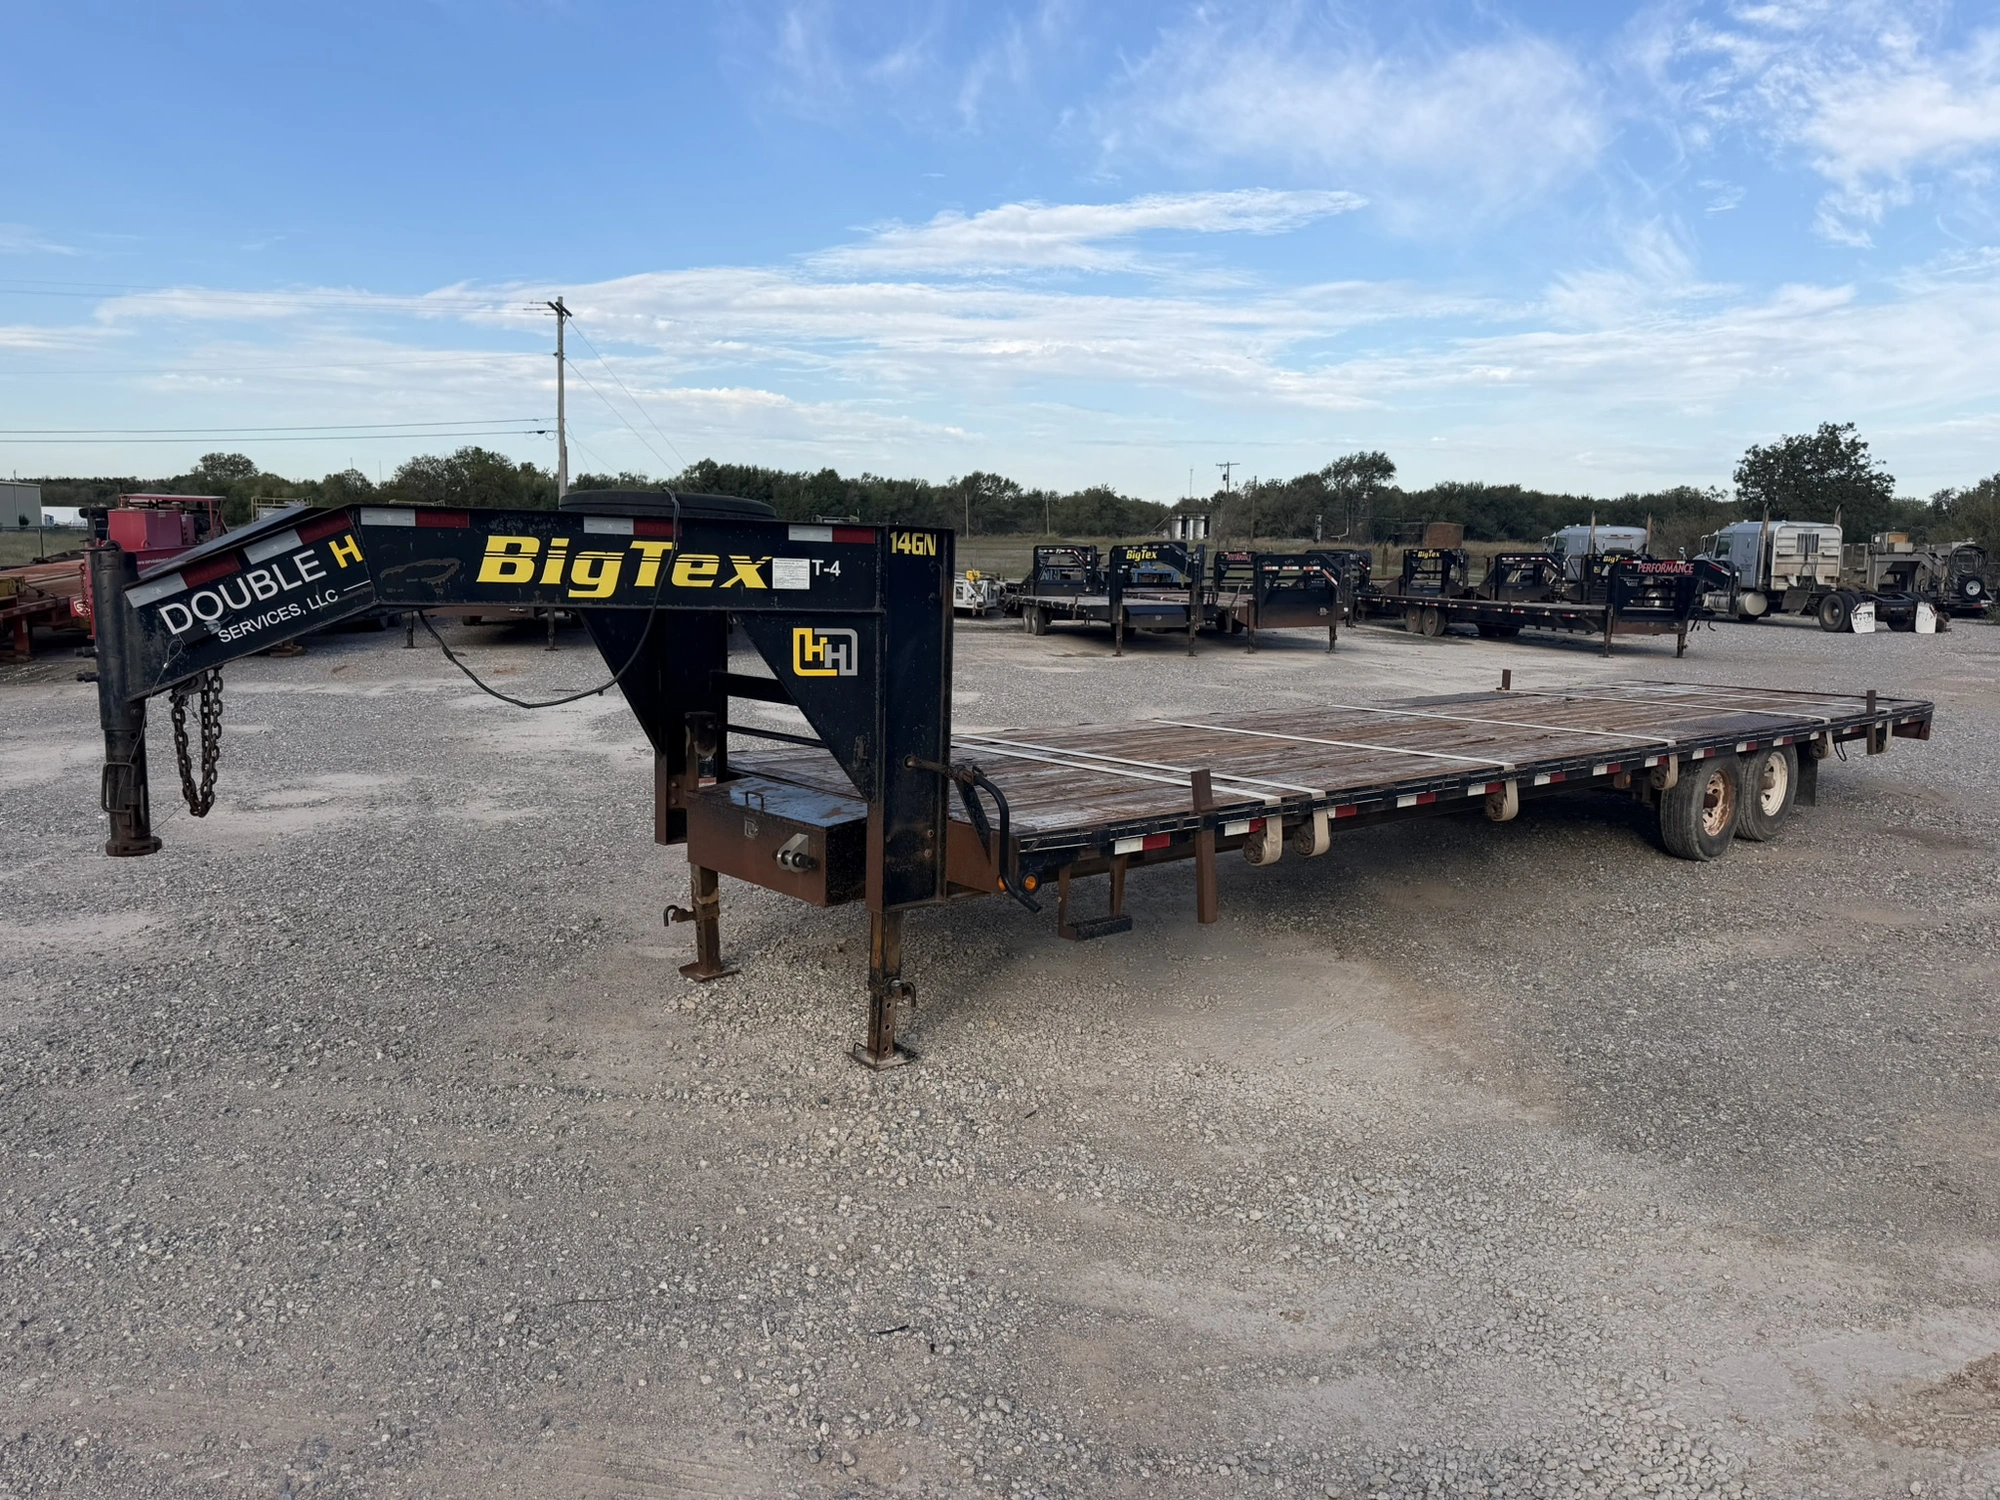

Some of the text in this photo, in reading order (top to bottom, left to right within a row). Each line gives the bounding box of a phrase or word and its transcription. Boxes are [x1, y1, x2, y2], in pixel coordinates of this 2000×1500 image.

[890, 531, 936, 556] 14GN
[1126, 549, 1157, 561] BigTex
[811, 559, 841, 577] T-4
[1637, 562, 1694, 573] PERFORMANCE
[159, 534, 364, 635] DOUBLE H
[218, 589, 339, 643] SERVICES, LLC
